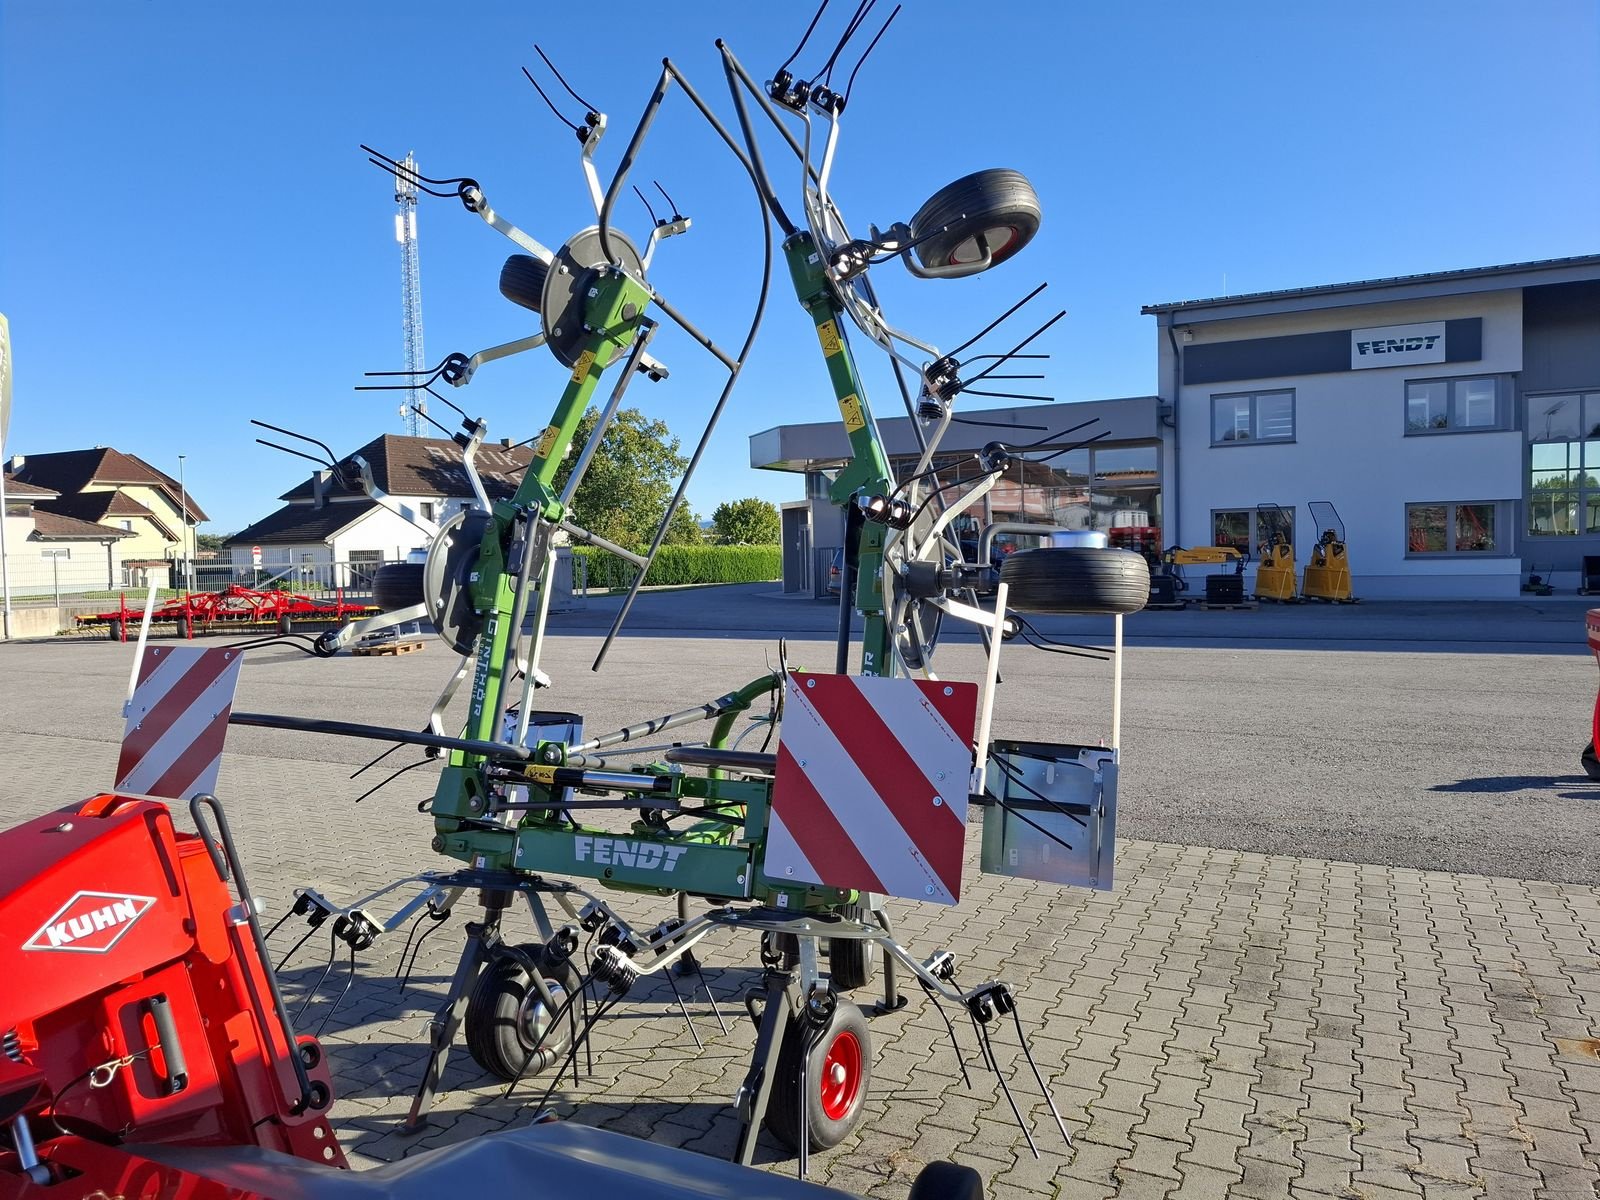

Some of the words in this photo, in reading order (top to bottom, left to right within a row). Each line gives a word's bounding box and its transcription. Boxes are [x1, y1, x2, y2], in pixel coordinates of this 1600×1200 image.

[1356, 335, 1441, 355] FENDT
[574, 835, 688, 872] FENDT
[45, 898, 138, 947] KUHN
